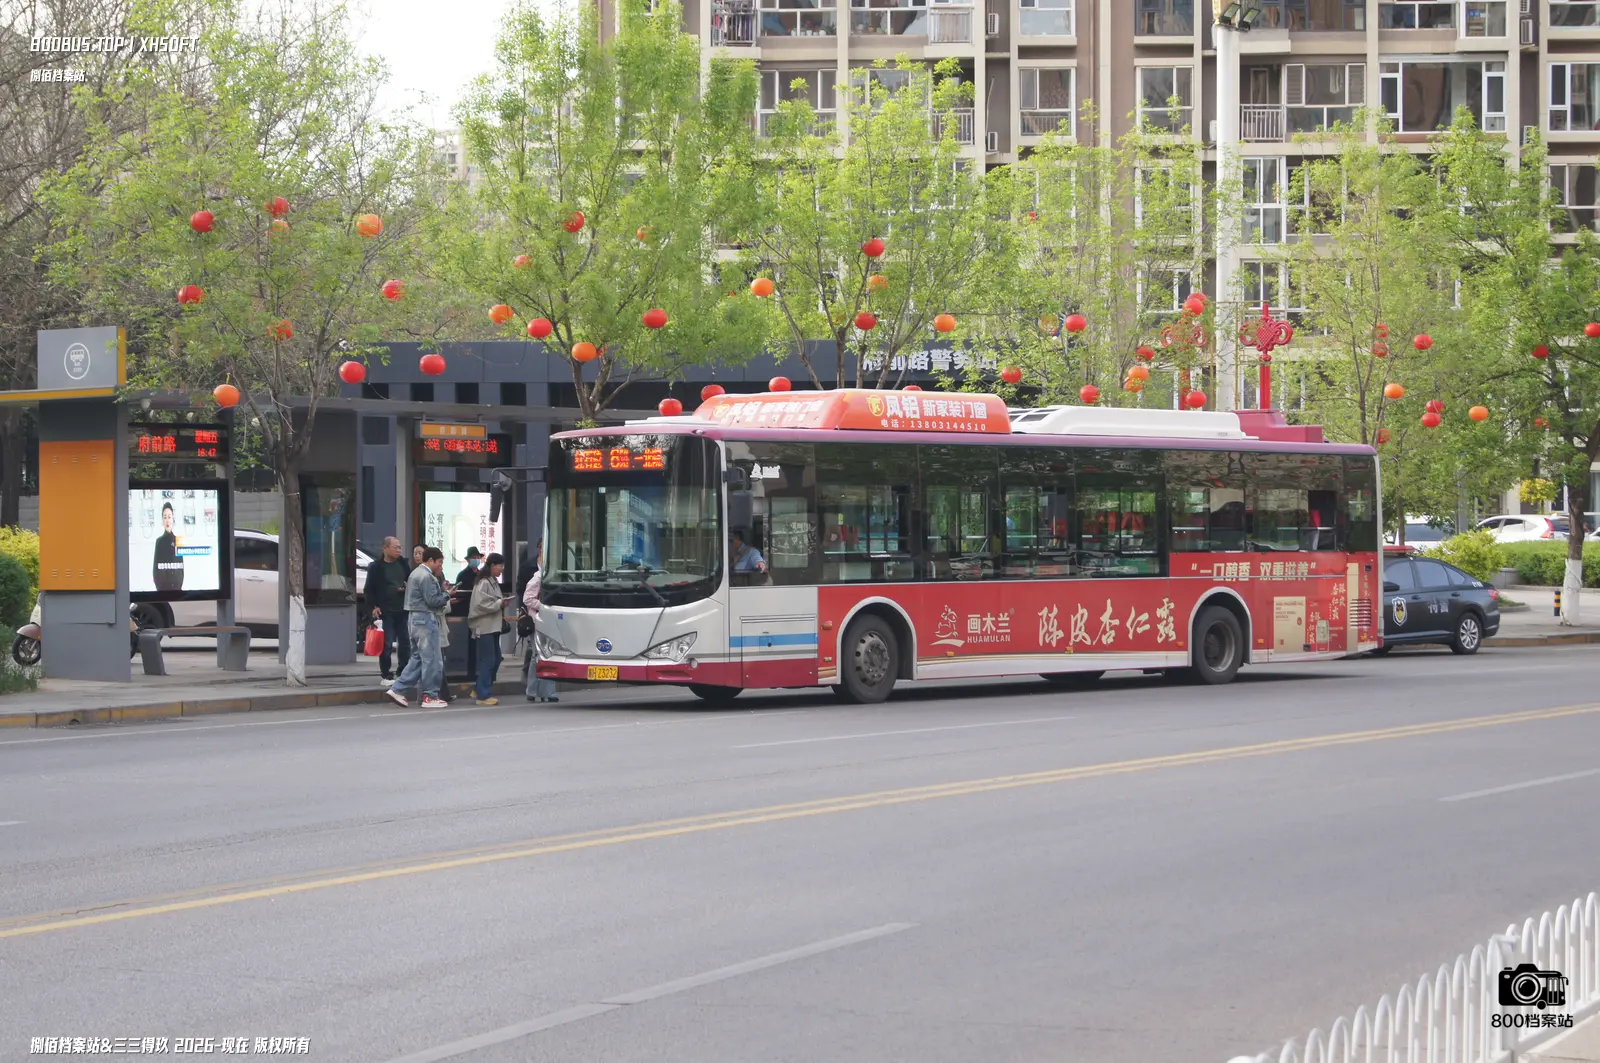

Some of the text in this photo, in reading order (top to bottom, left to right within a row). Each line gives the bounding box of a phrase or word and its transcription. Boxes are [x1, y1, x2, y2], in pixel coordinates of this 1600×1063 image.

[885, 395, 988, 419] 凤铝 新家装门窗
[138, 435, 176, 453] 府前路
[967, 612, 1011, 634] 画木兰
[1037, 598, 1177, 648] 陈皮杏仁露
[967, 635, 1011, 643] HUAMULAN
